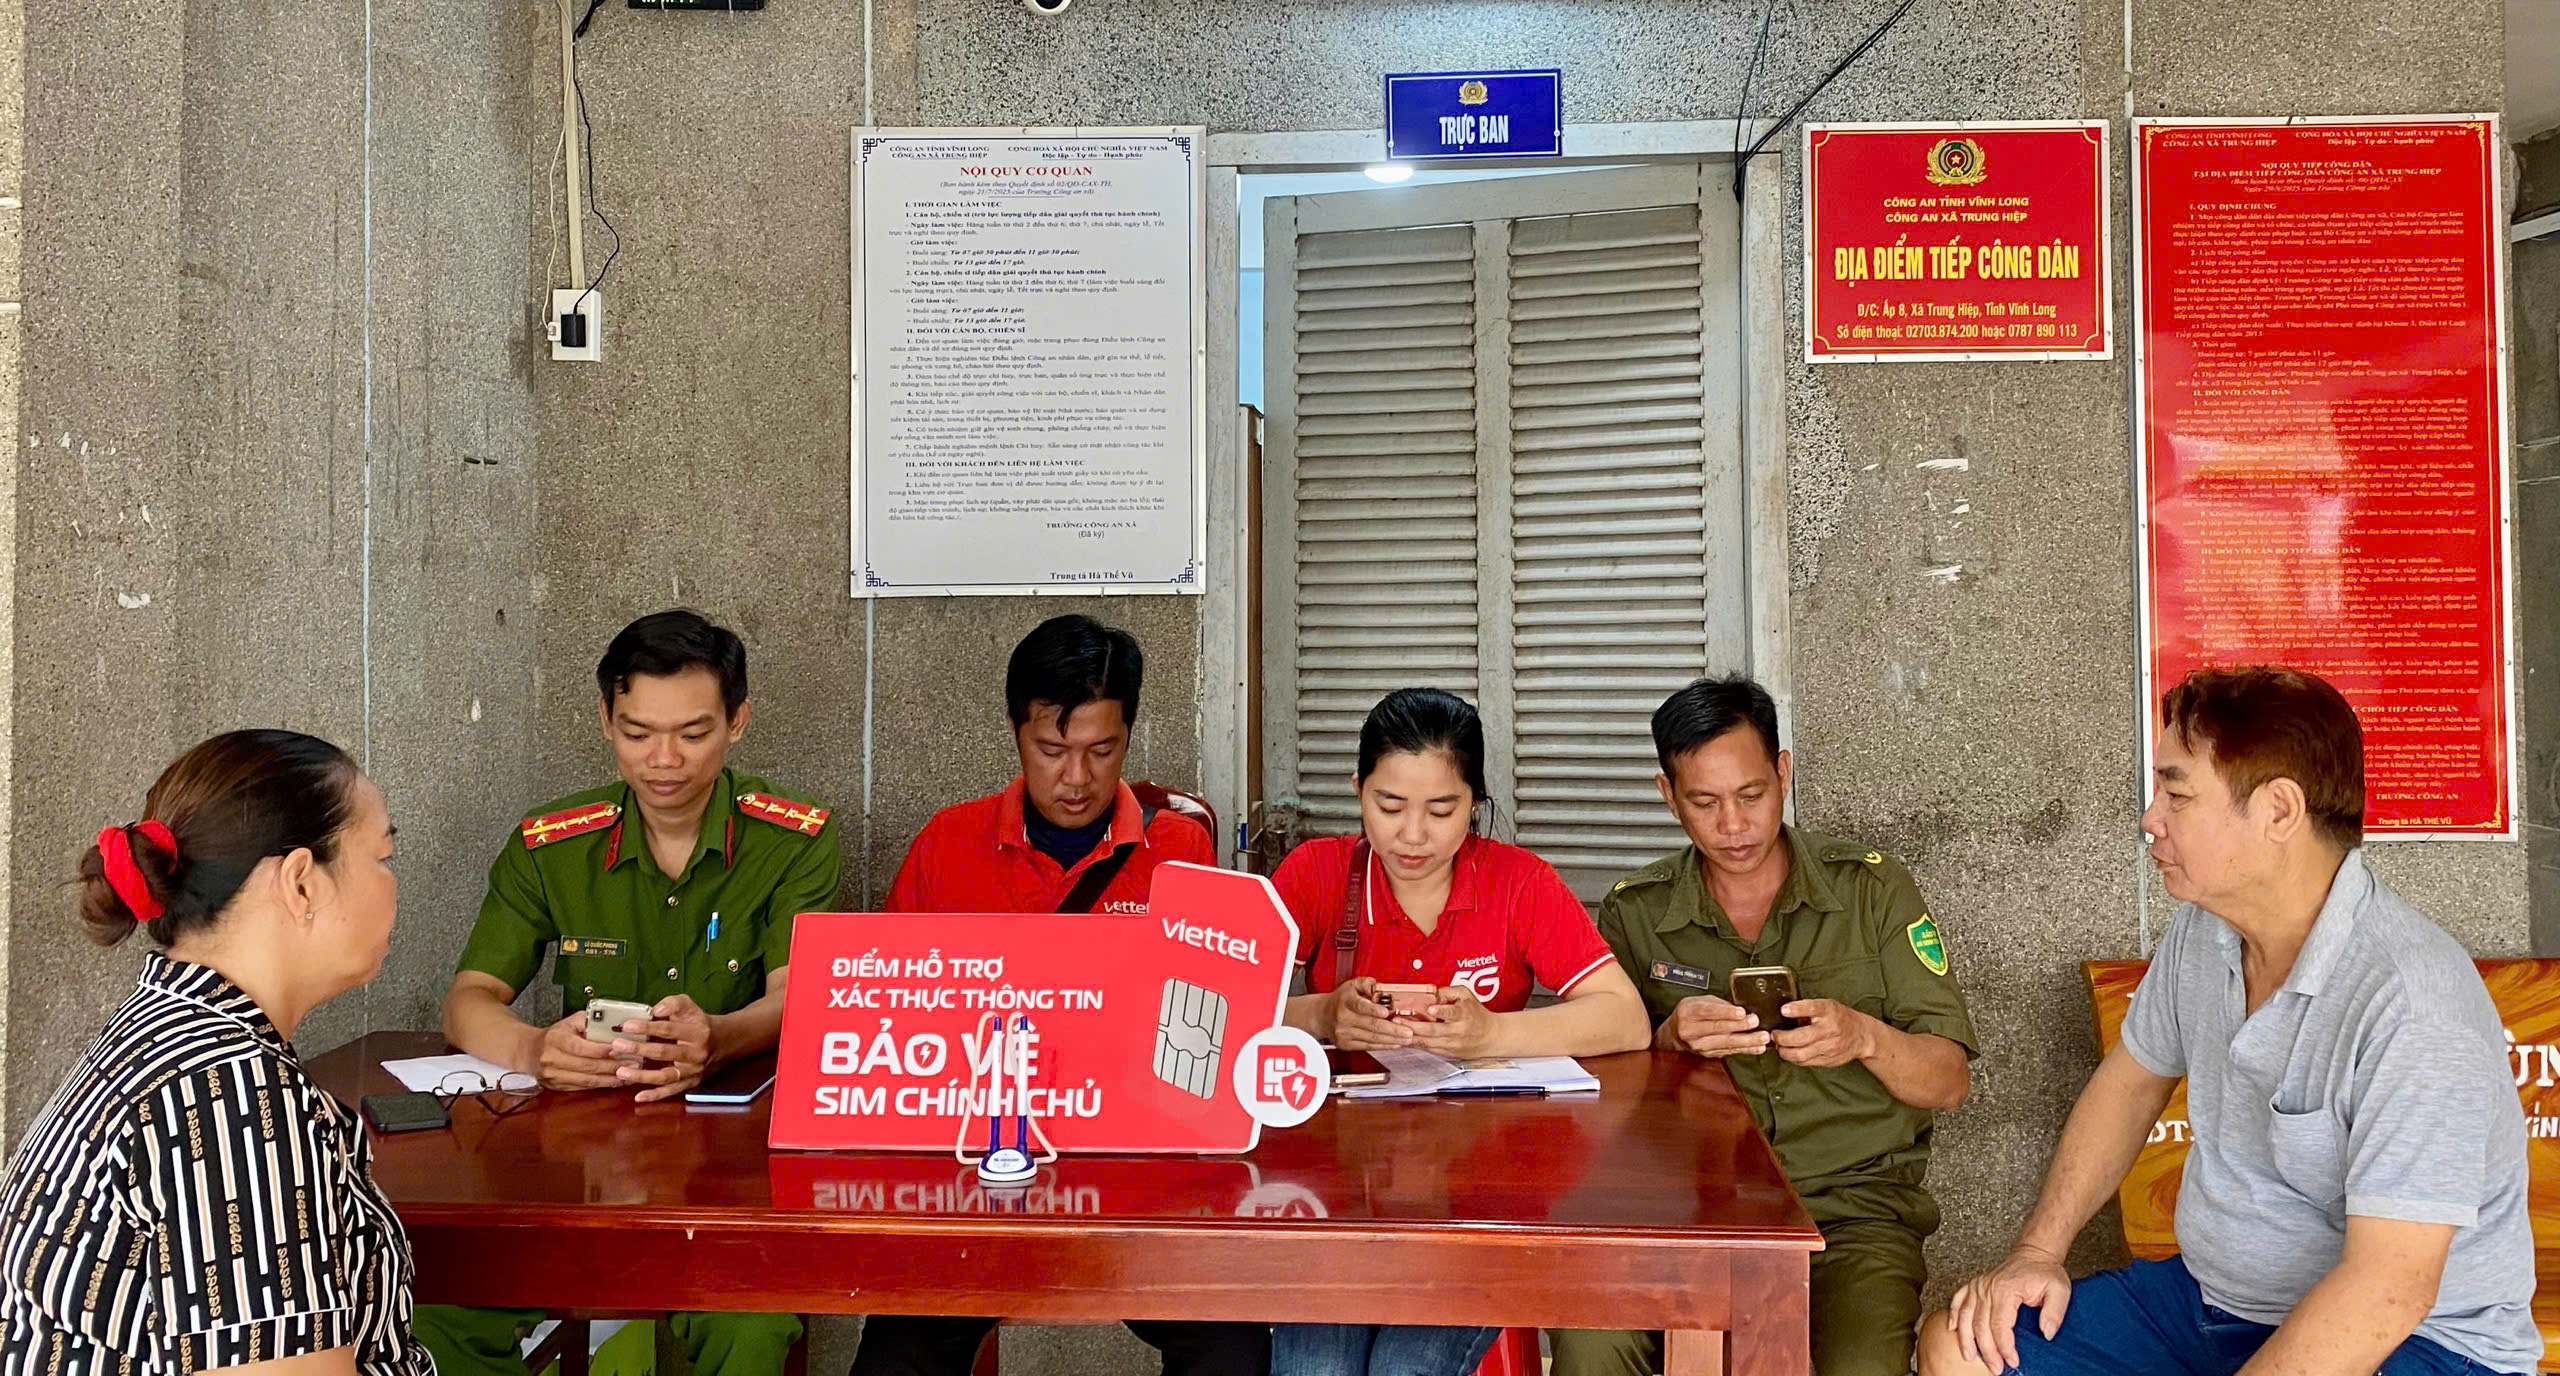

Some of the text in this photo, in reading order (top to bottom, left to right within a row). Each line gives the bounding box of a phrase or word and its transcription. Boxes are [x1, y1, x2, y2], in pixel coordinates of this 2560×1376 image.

[1439, 113, 1508, 150] TRỰC BAN
[961, 166, 1093, 178] NỘI QUY CƠ QUAN
[1884, 195, 2029, 207] CÔNG AN TỈNH VĨNH LONG
[1886, 211, 2028, 224] CÔNG AN XÃ TRUNG HIỆP
[1834, 233, 2079, 288] ĐỊA ĐIỂM TIẾP CÔNG DÂN
[1857, 299, 2056, 319] Đ/C: Ấp 8, Xã Trung Hiệp, Tỉnh Vĩnh Long
[1836, 324, 2077, 340] Số điện thoại: 02703.874.200 hoặc 0787 890 113
[1078, 530, 1105, 539] (Đã ký)
[1050, 572, 1076, 580] Trung
[1089, 571, 1101, 579] Hà
[1103, 570, 1119, 579] Thế
[1121, 571, 1133, 579] Vũ
[1103, 901, 1149, 914] vettel
[1162, 918, 1260, 965] viettel
[832, 948, 1004, 982] ĐIỂM HỖ TRỢ
[1457, 954, 1498, 967] viettel
[827, 982, 1103, 1012] XÁC THỰC THÔNG TIN
[820, 1018, 947, 1076] BẢO
[814, 1078, 1102, 1117] SIM CHÍNH CHỦ
